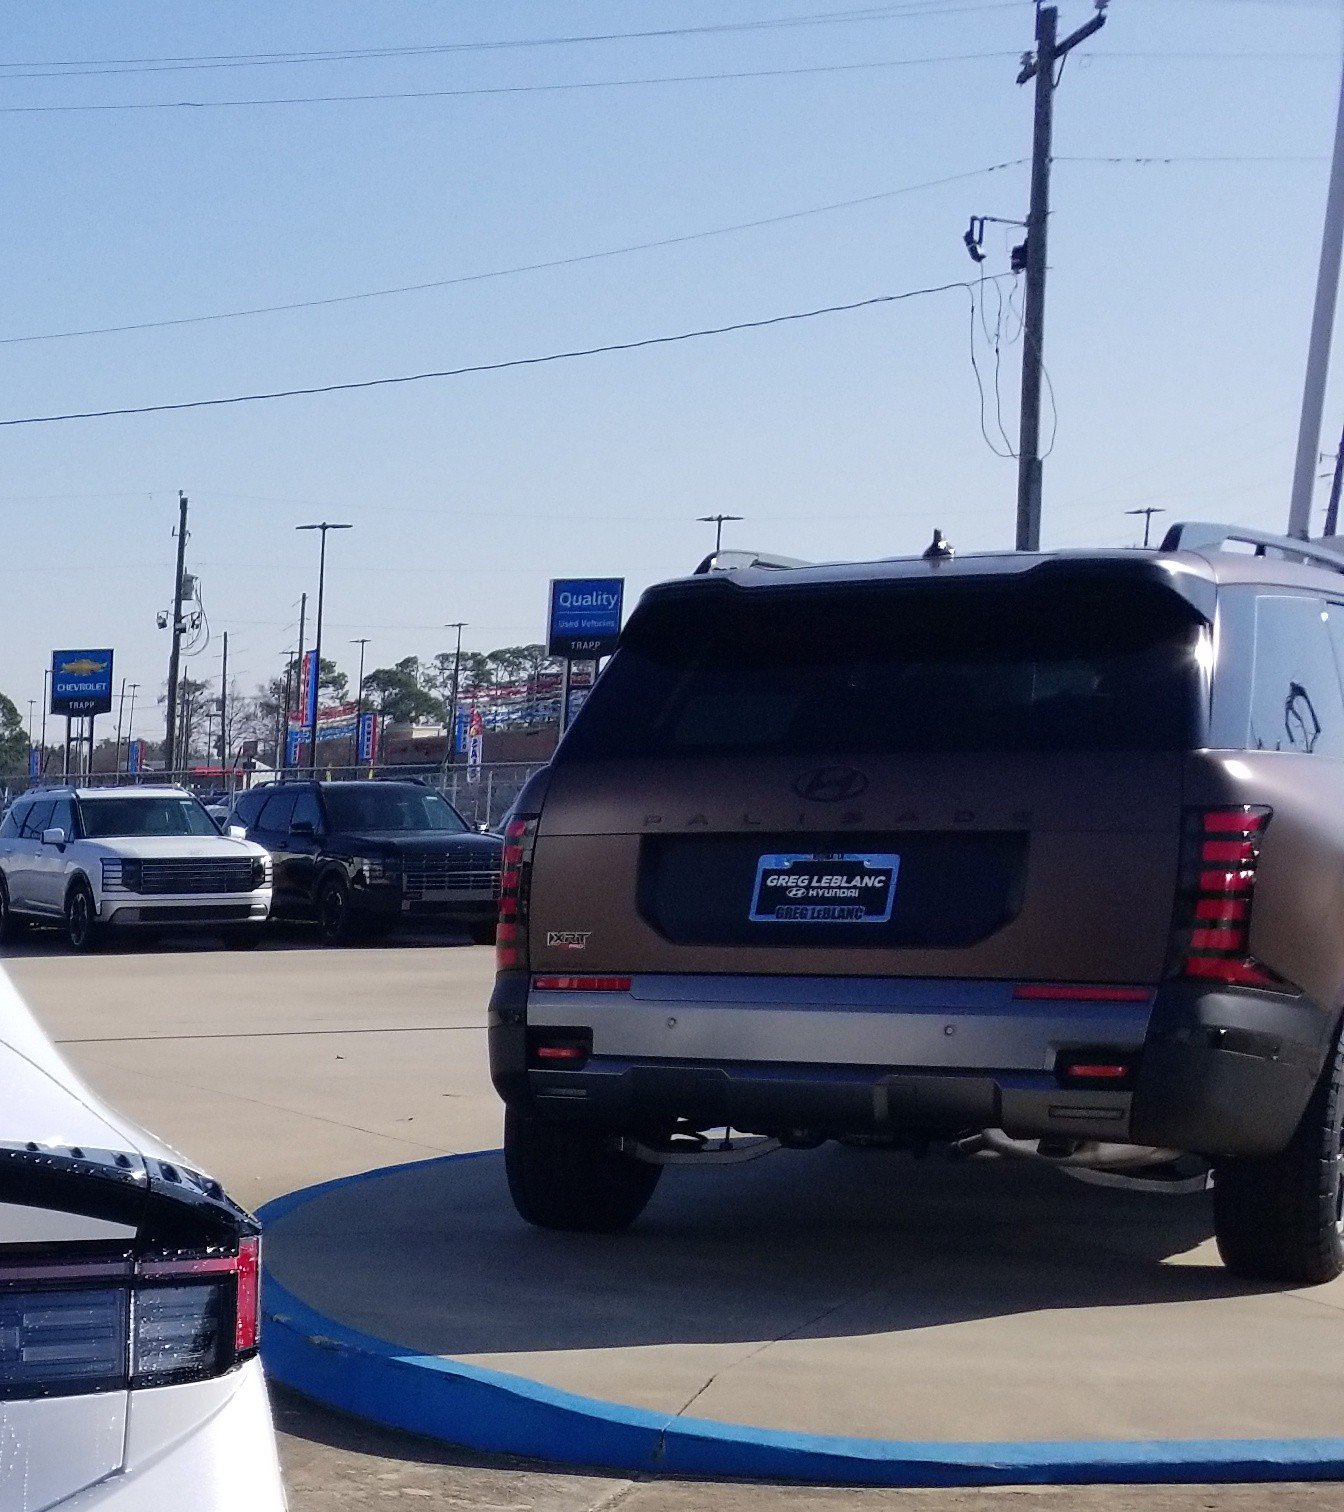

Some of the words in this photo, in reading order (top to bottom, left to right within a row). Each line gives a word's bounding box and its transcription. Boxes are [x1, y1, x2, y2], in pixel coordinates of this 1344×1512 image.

[559, 590, 618, 609] Quality
[558, 619, 579, 628] Used
[571, 641, 601, 650] TRAPP
[57, 682, 107, 692] CHEVROLET
[69, 701, 95, 709] TRAPP
[766, 875, 809, 887] GREG
[811, 875, 886, 887] LEBLANC
[809, 888, 859, 897] HYUNDAI
[776, 906, 809, 920] GREG
[548, 931, 592, 946] XRT
